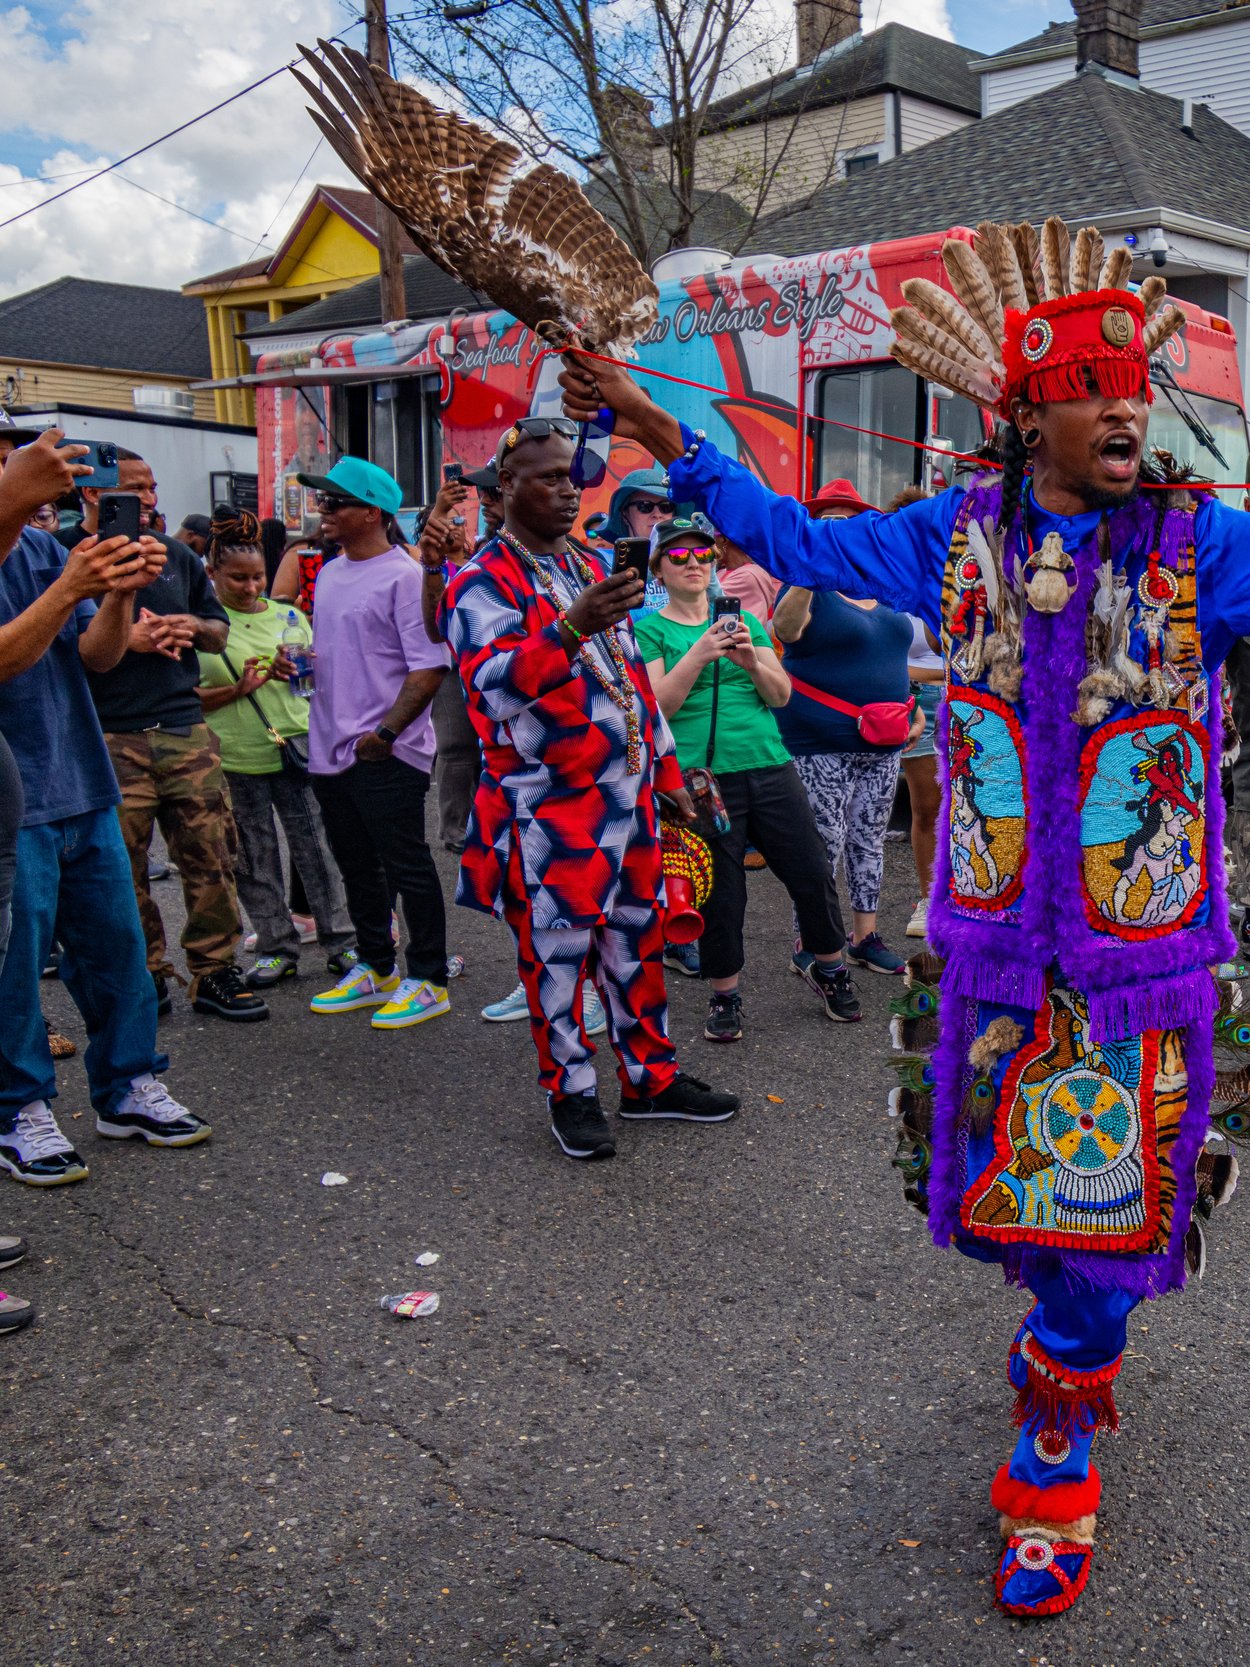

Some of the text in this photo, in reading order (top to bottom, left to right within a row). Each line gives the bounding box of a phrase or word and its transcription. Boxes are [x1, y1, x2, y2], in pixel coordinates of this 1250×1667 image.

[640, 273, 845, 346] ew Orleans Style
[452, 328, 528, 382] Seafood
